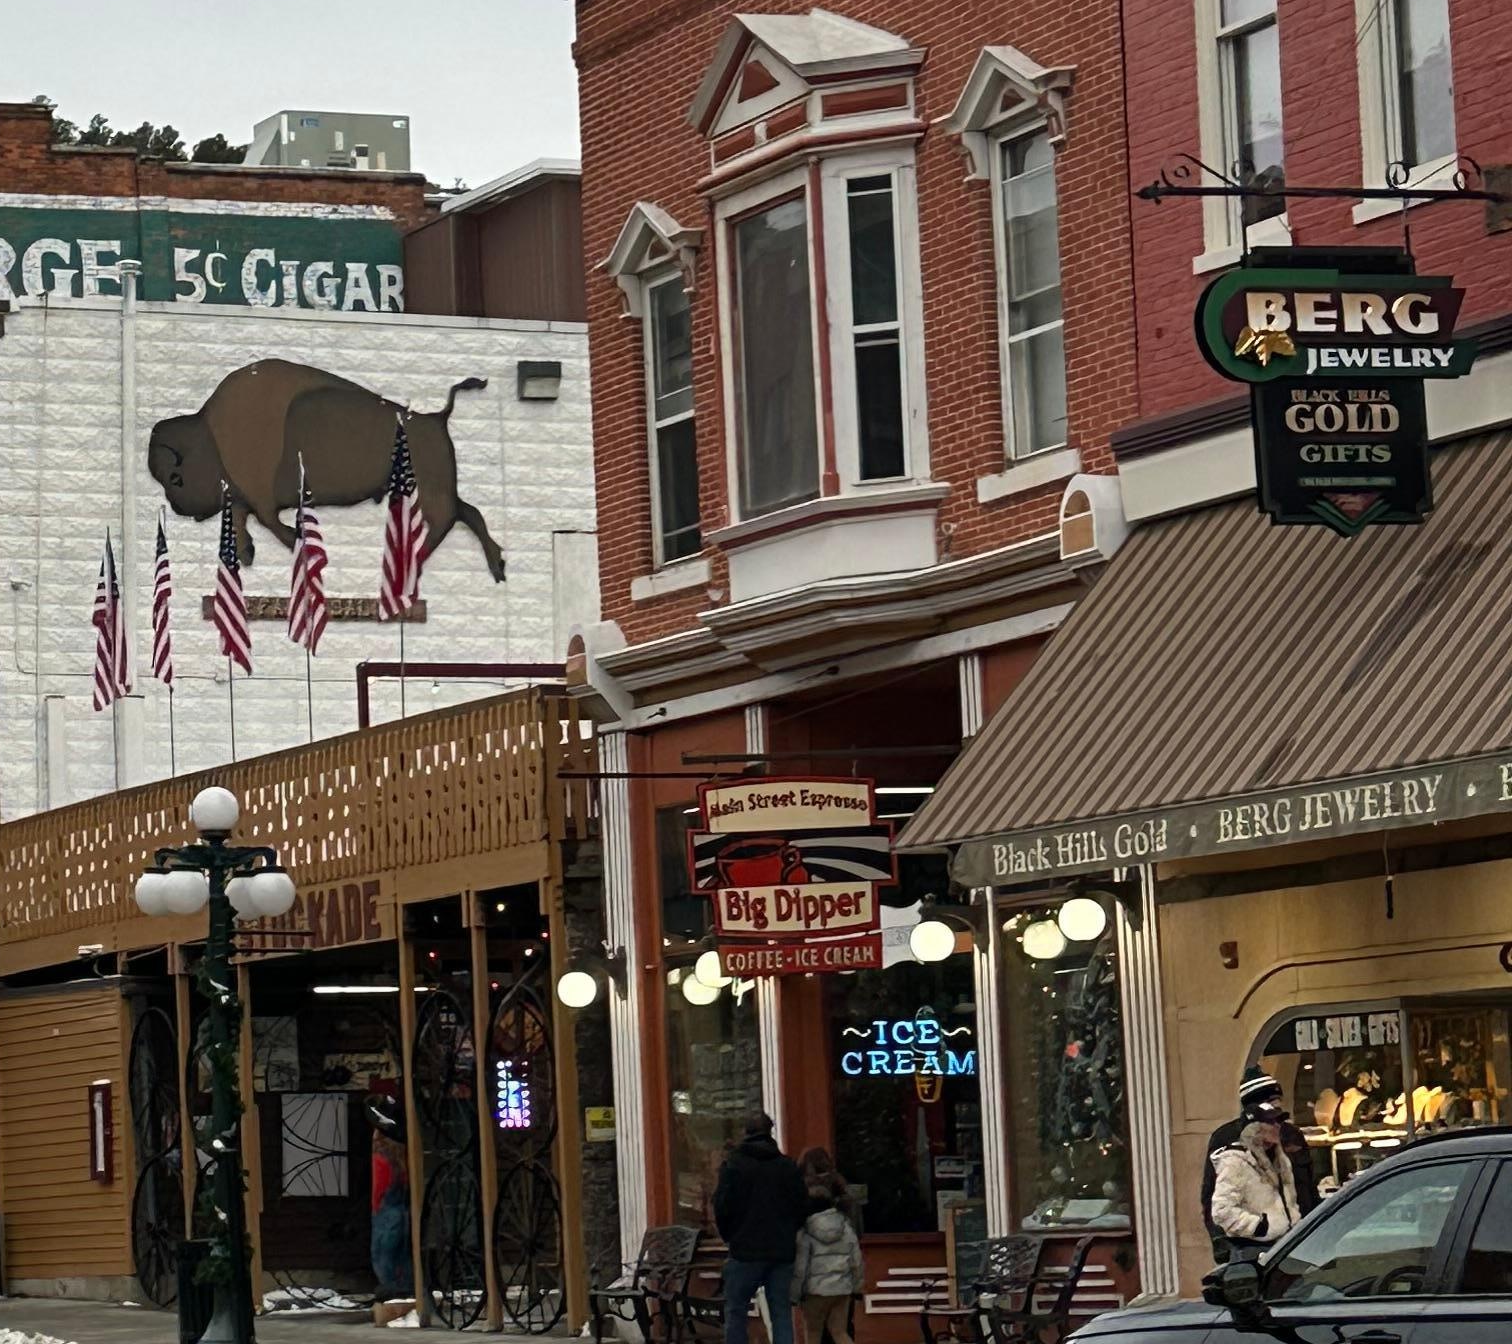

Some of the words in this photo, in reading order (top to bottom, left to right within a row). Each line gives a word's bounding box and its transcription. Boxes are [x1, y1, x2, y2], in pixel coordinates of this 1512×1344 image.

[240, 248, 405, 312] CIGAR
[1246, 292, 1439, 335] BERG
[1306, 347, 1455, 374] JEWELRY
[1285, 404, 1399, 433] GOLD
[1299, 445, 1391, 463] GIFTS
[748, 793, 796, 812] Street
[992, 843, 1050, 876] Black
[1113, 819, 1167, 859] Gold
[1216, 802, 1291, 843] BERG
[1299, 775, 1443, 831] JEWELRY
[239, 880, 382, 948] CKADE
[725, 890, 768, 930] Big
[774, 887, 866, 928] Dipper
[825, 946, 874, 965] CREAM
[872, 1019, 940, 1044] ICE
[841, 1050, 976, 1075] CREAM
